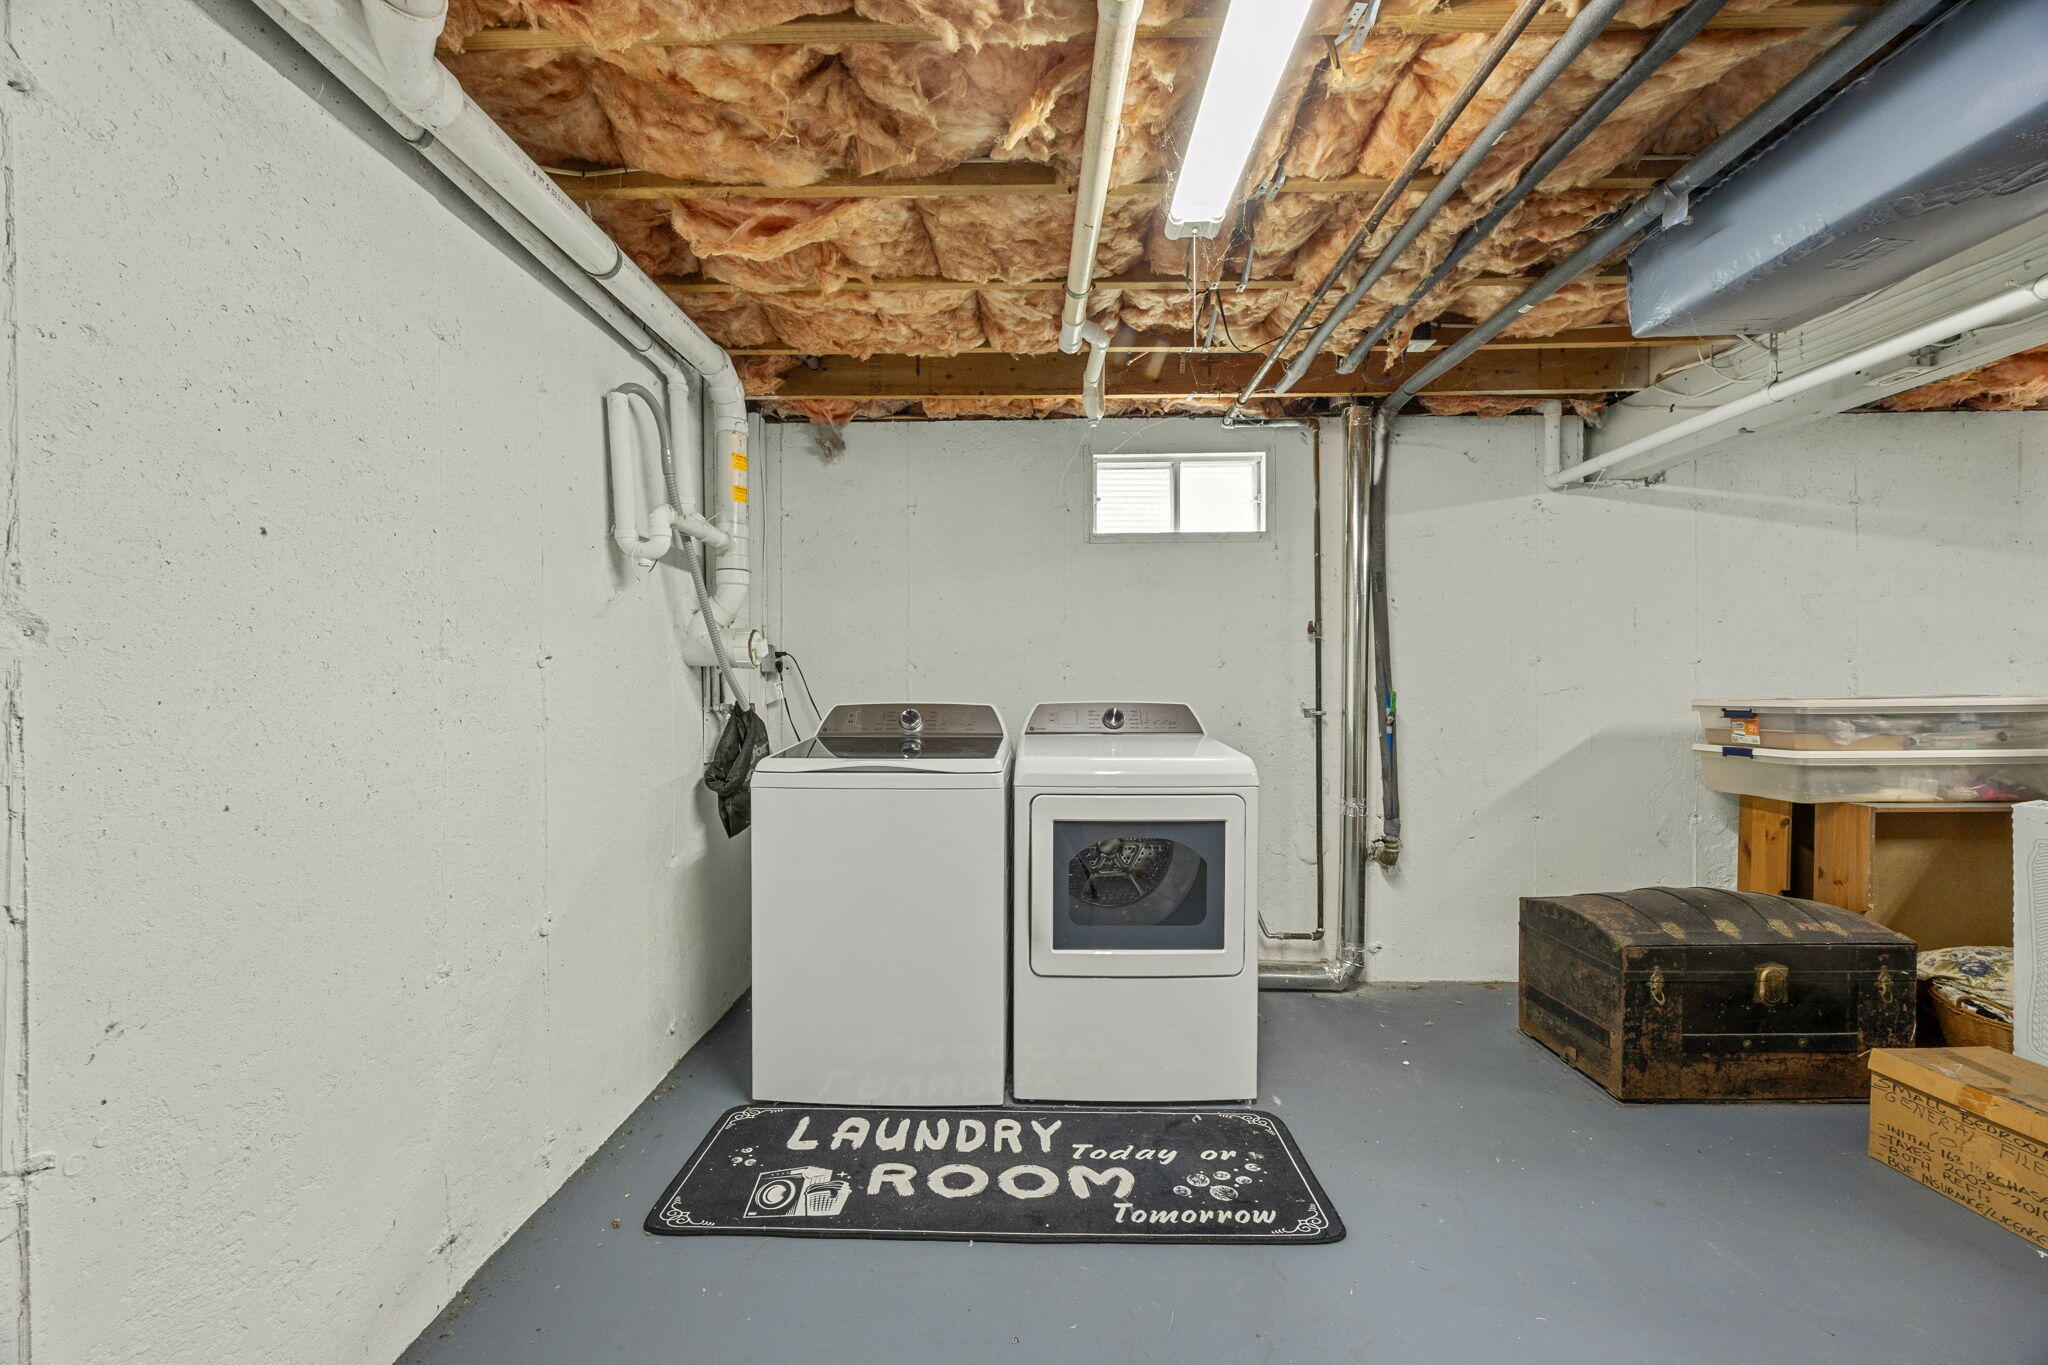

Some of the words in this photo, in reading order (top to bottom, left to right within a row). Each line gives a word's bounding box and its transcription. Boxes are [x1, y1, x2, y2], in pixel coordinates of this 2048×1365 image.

[1873, 1078, 1946, 1113] SMALL
[786, 1116, 1062, 1153] LAUNDRY
[1886, 1124, 1934, 1152] INITIAL
[1072, 1144, 1178, 1165] Today
[1200, 1150, 1237, 1161] or
[1884, 1134, 1931, 1162] TAXES
[1944, 1163, 1992, 1191] 2003
[1888, 1146, 1930, 1172] BOTH
[2000, 1143, 2048, 1178] FILE
[867, 1162, 1135, 1199] ROOM
[1113, 1202, 1277, 1224] Tomorrow
